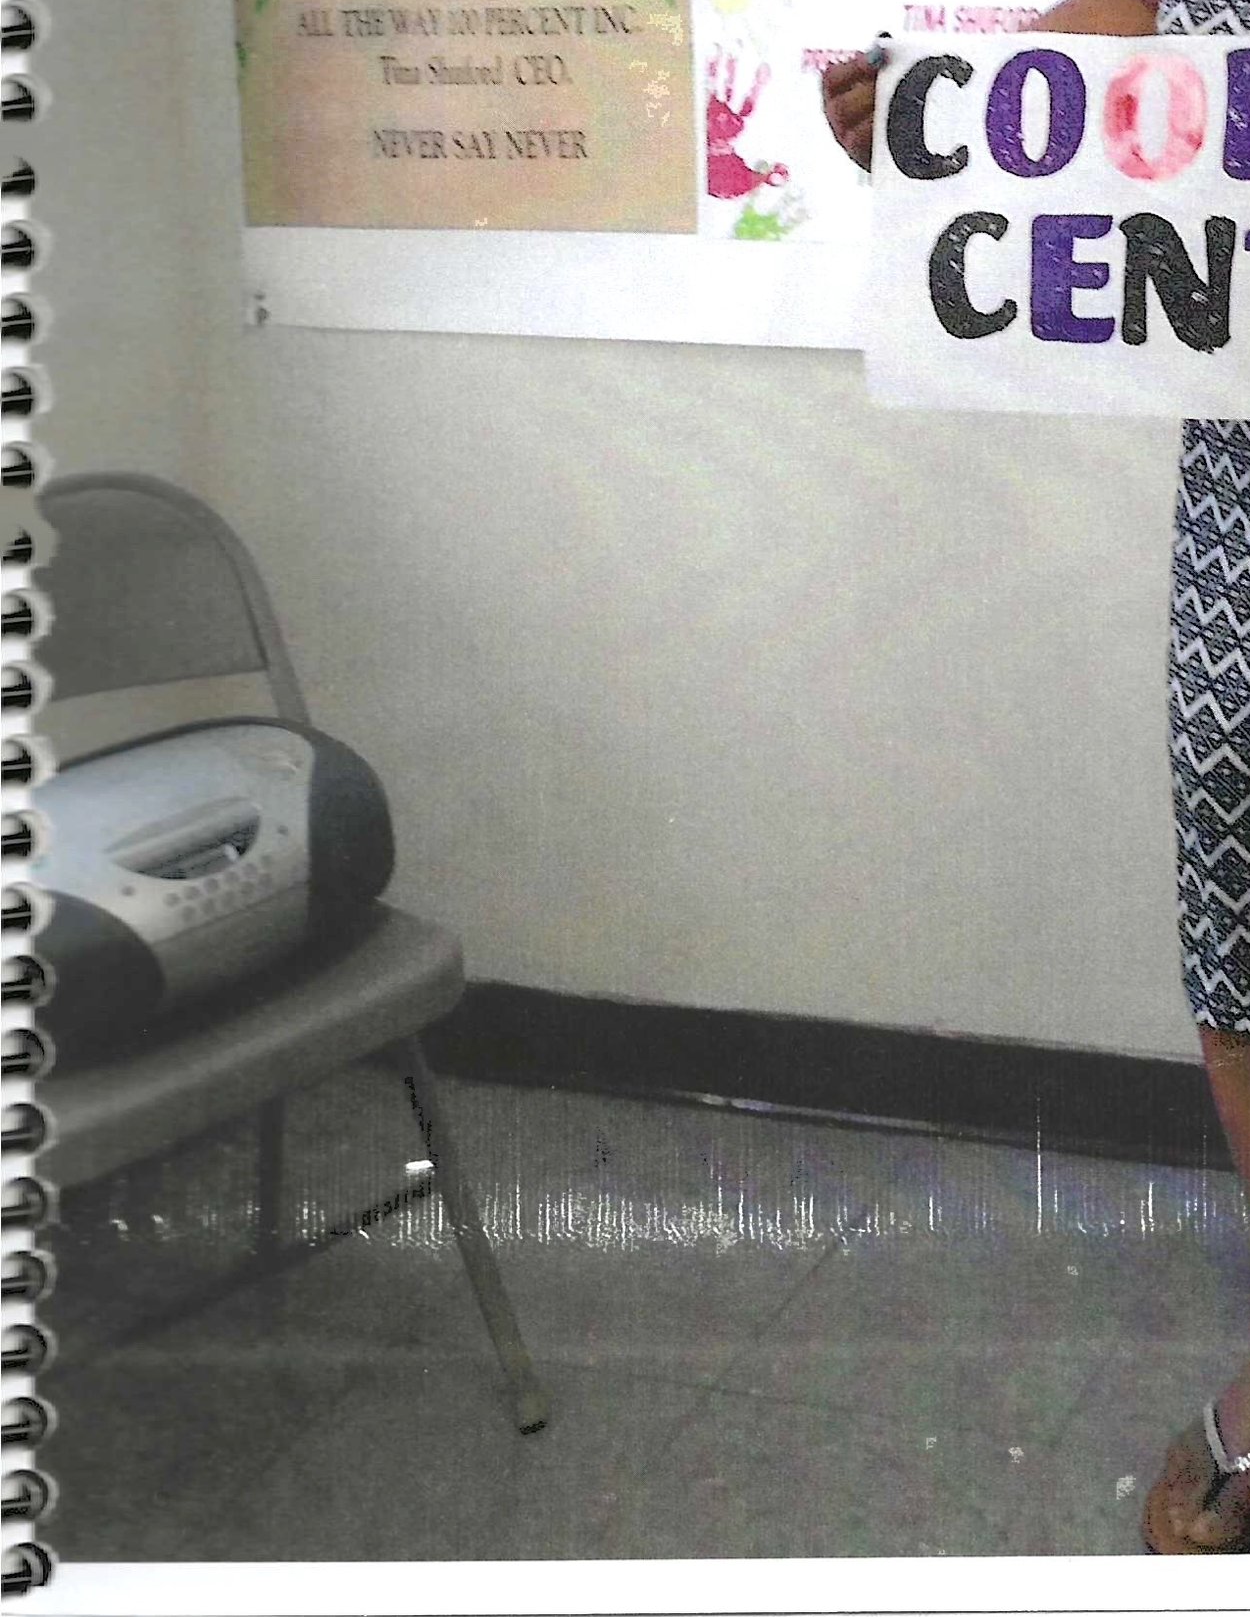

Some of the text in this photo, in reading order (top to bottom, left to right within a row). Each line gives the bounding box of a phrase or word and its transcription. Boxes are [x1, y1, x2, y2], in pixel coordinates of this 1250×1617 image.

[299, 10, 334, 37] ALL
[340, 10, 386, 37] THE
[388, 9, 443, 36] WAY
[484, 7, 587, 36] PERCENT
[372, 129, 591, 160] NEVER SAY NEVER
